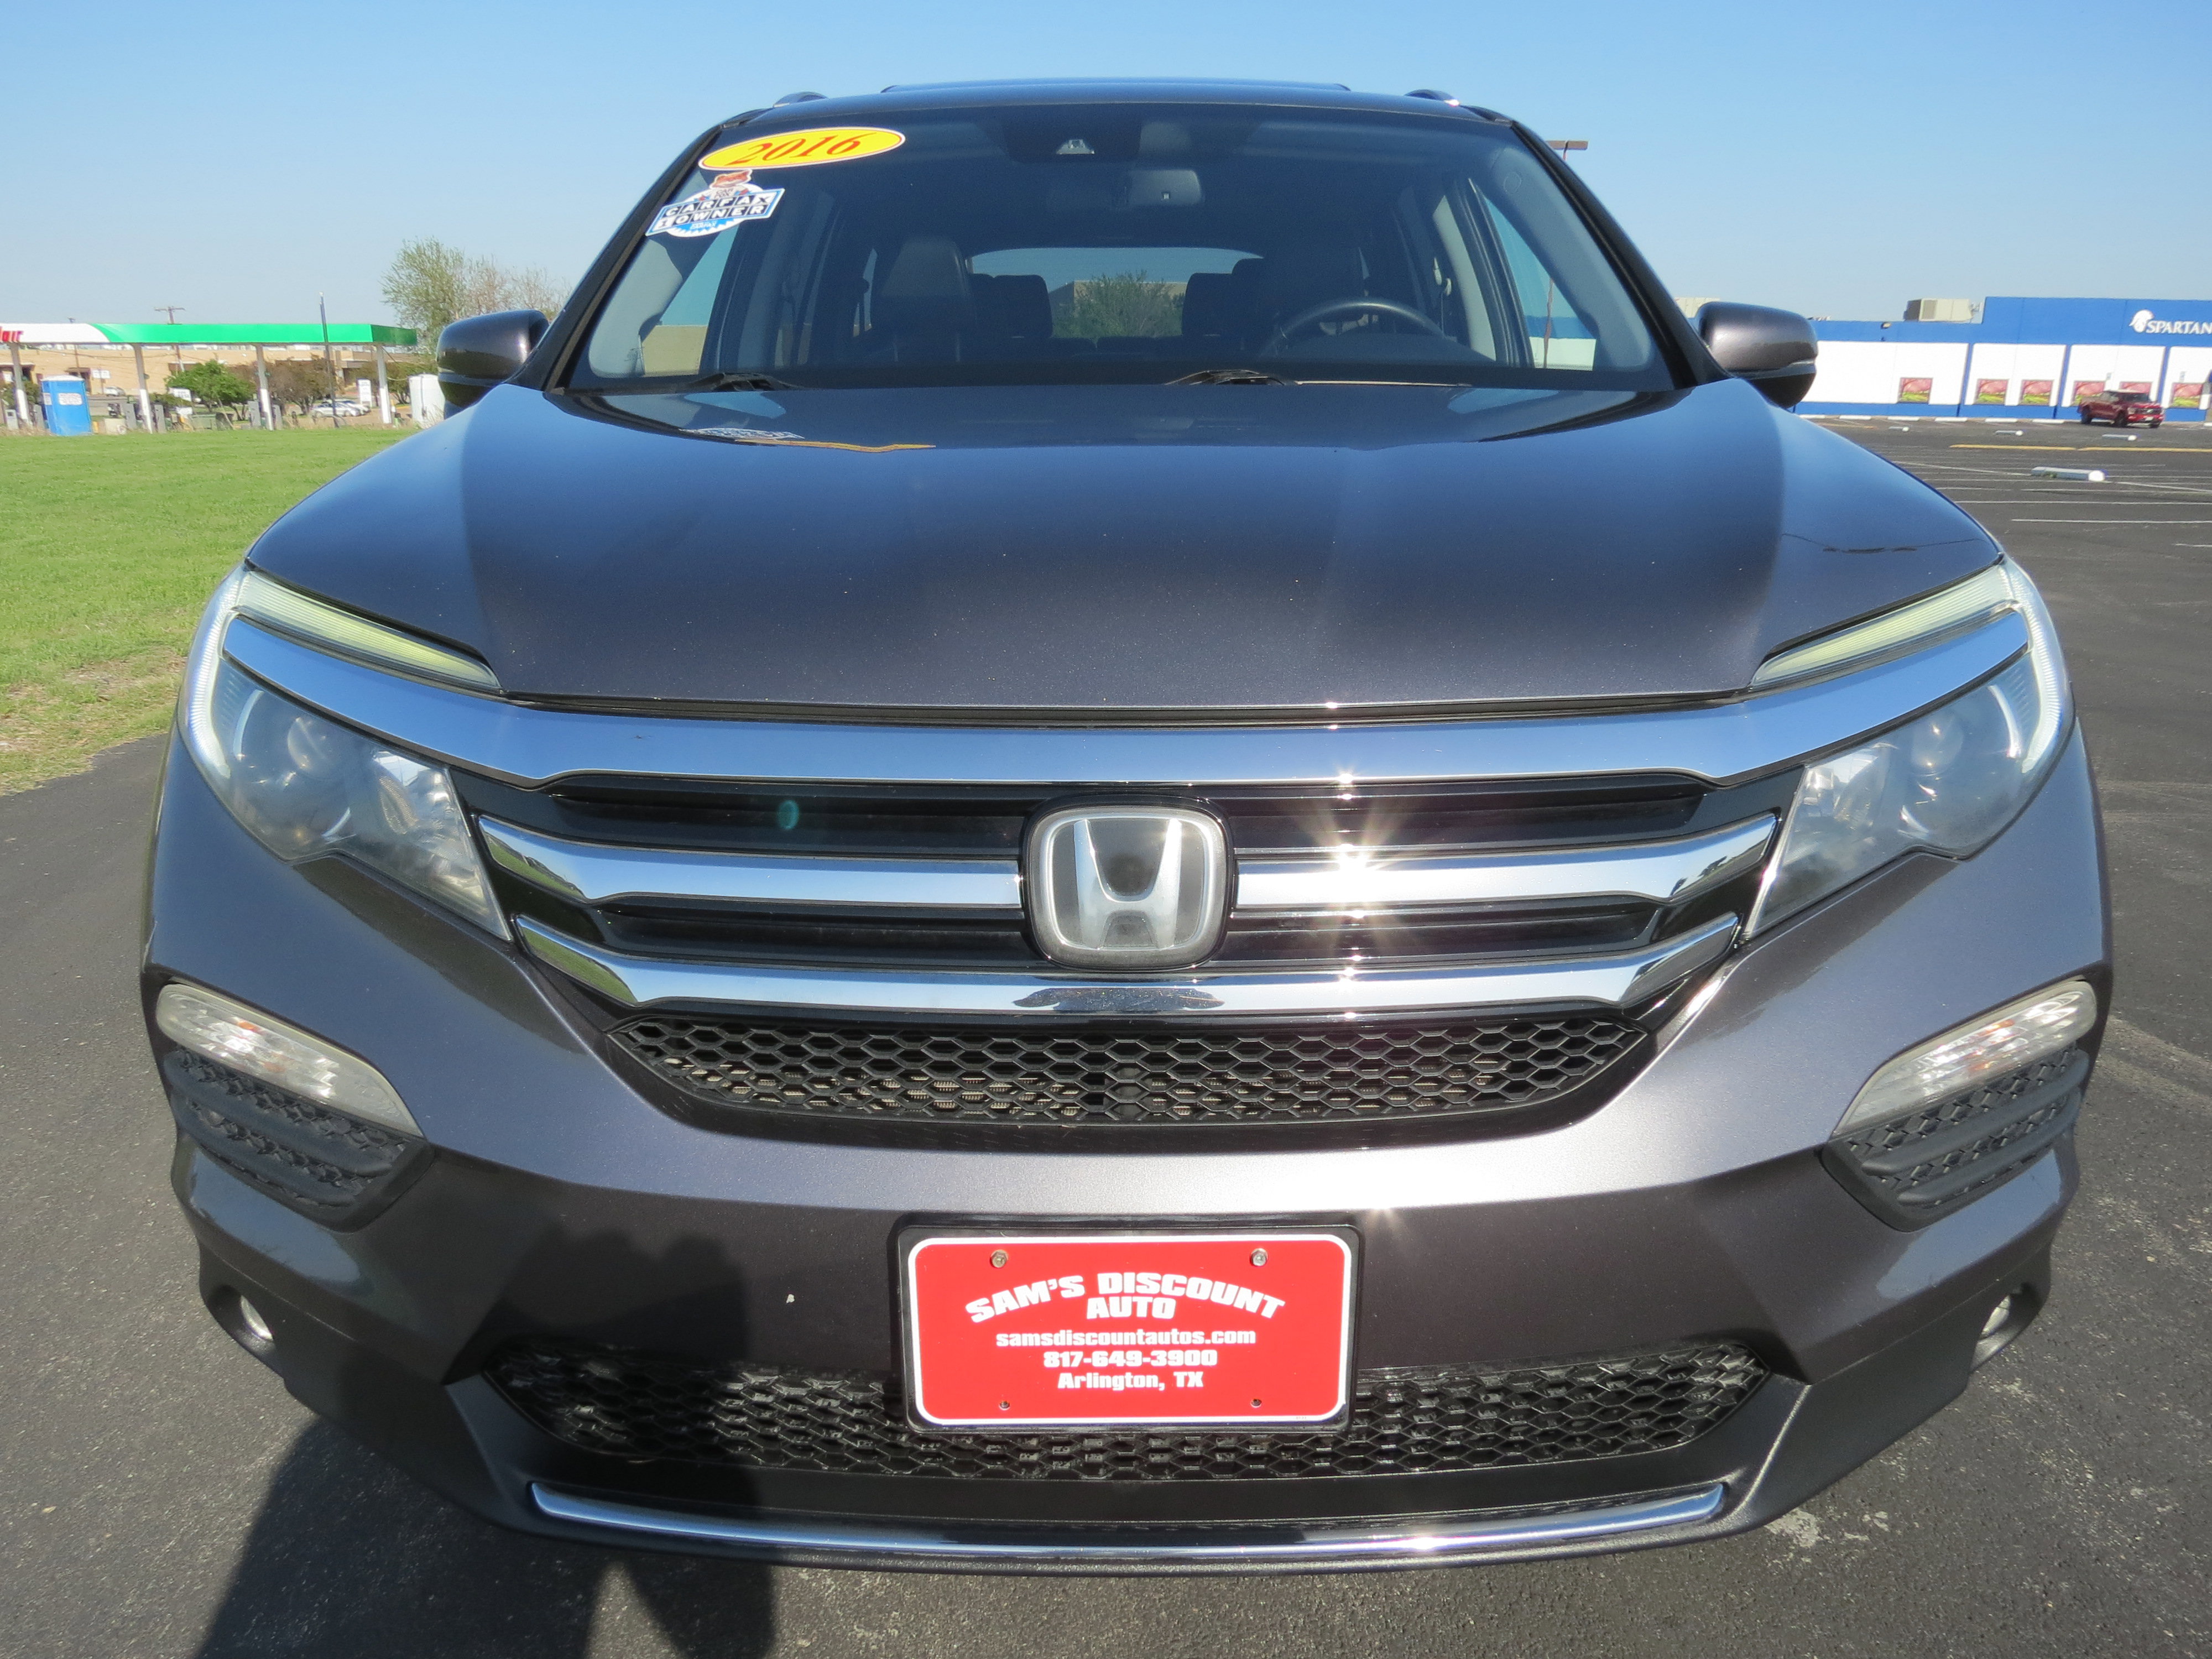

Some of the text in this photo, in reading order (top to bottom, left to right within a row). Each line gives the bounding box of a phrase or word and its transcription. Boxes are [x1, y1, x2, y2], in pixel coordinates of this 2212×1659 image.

[724, 132, 878, 166] 2016
[665, 195, 772, 217] CARFAX
[676, 205, 764, 225] OWNER
[2146, 320, 2212, 335] SPARTAN
[964, 1272, 1286, 1323] SAM'S DISCOUNT
[1086, 1296, 1177, 1319] AUTO
[996, 1328, 1257, 1347] samsdiscountautos.com
[1043, 1349, 1218, 1368] 817-649-3900
[1057, 1371, 1204, 1391] Arlington, TX
